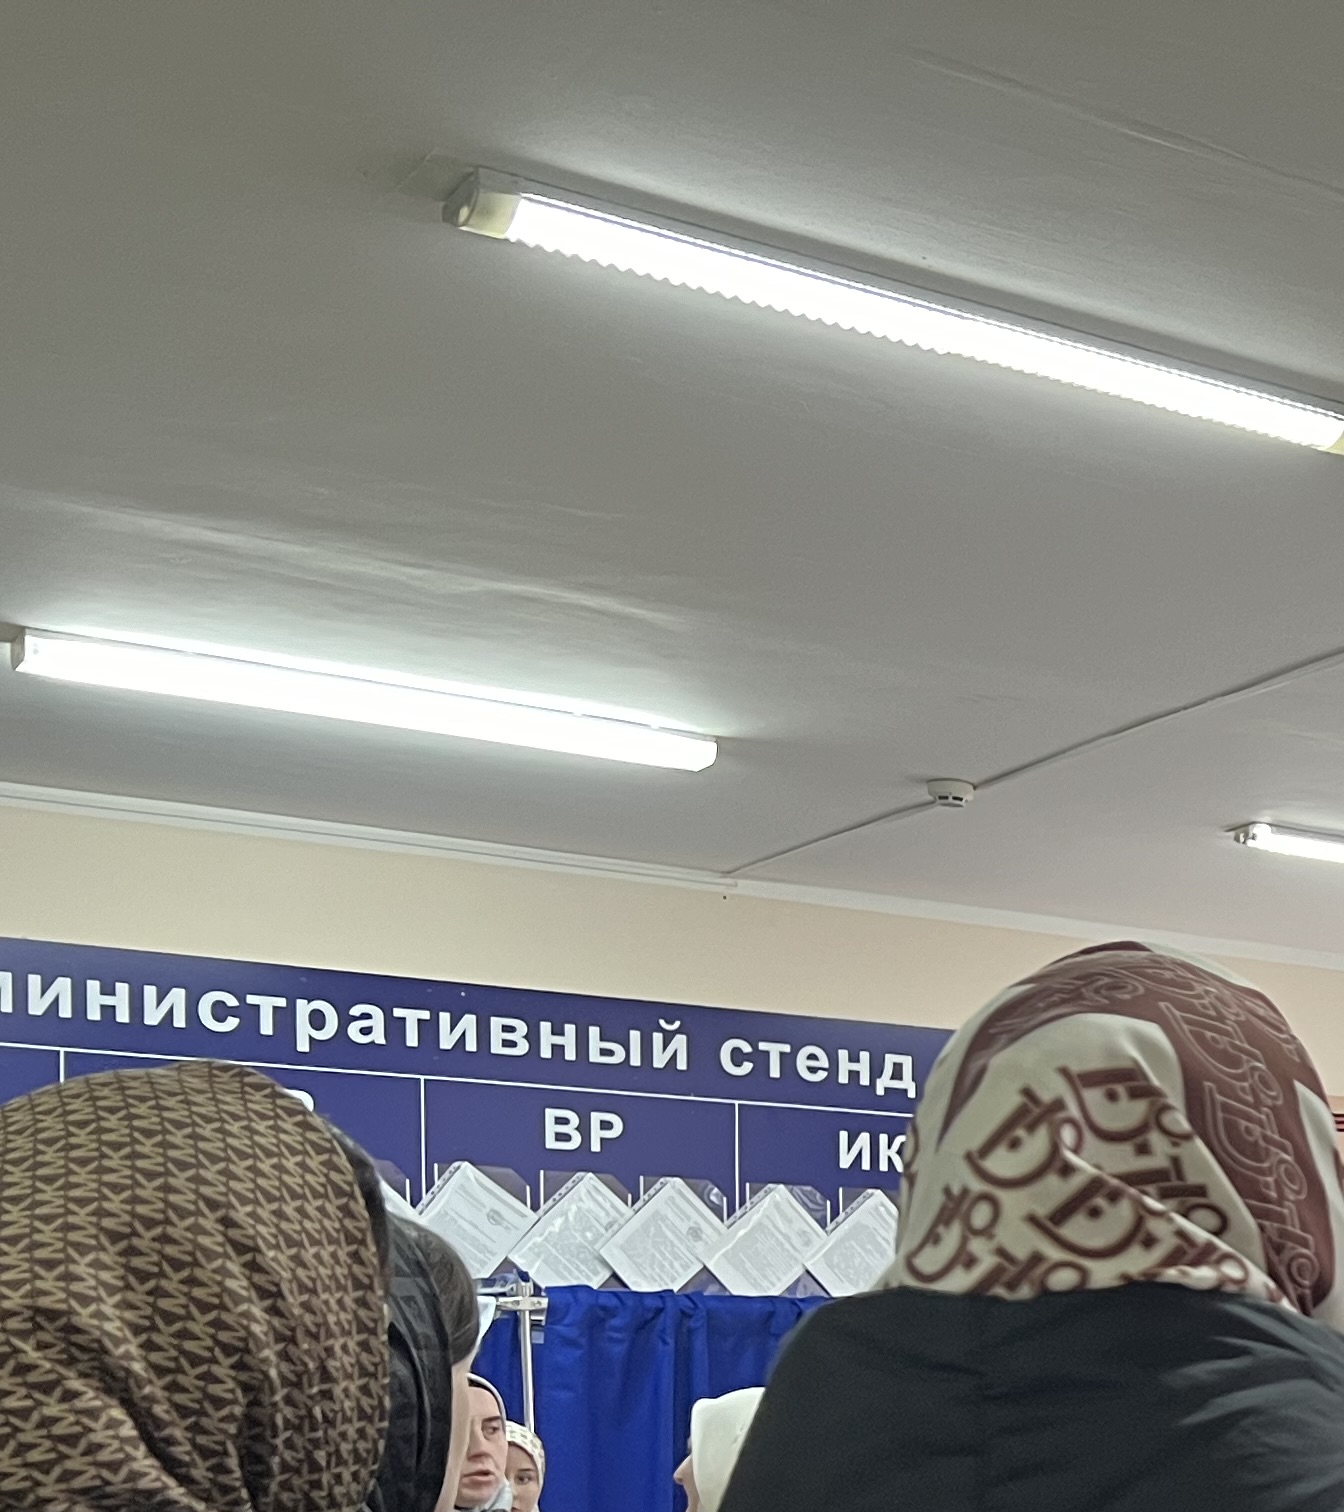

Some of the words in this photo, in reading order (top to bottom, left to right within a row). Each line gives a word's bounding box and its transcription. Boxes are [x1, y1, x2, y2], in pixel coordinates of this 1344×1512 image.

[0, 970, 691, 1072] инистративный
[719, 1037, 917, 1099] стенд
[544, 1107, 625, 1154] ВР
